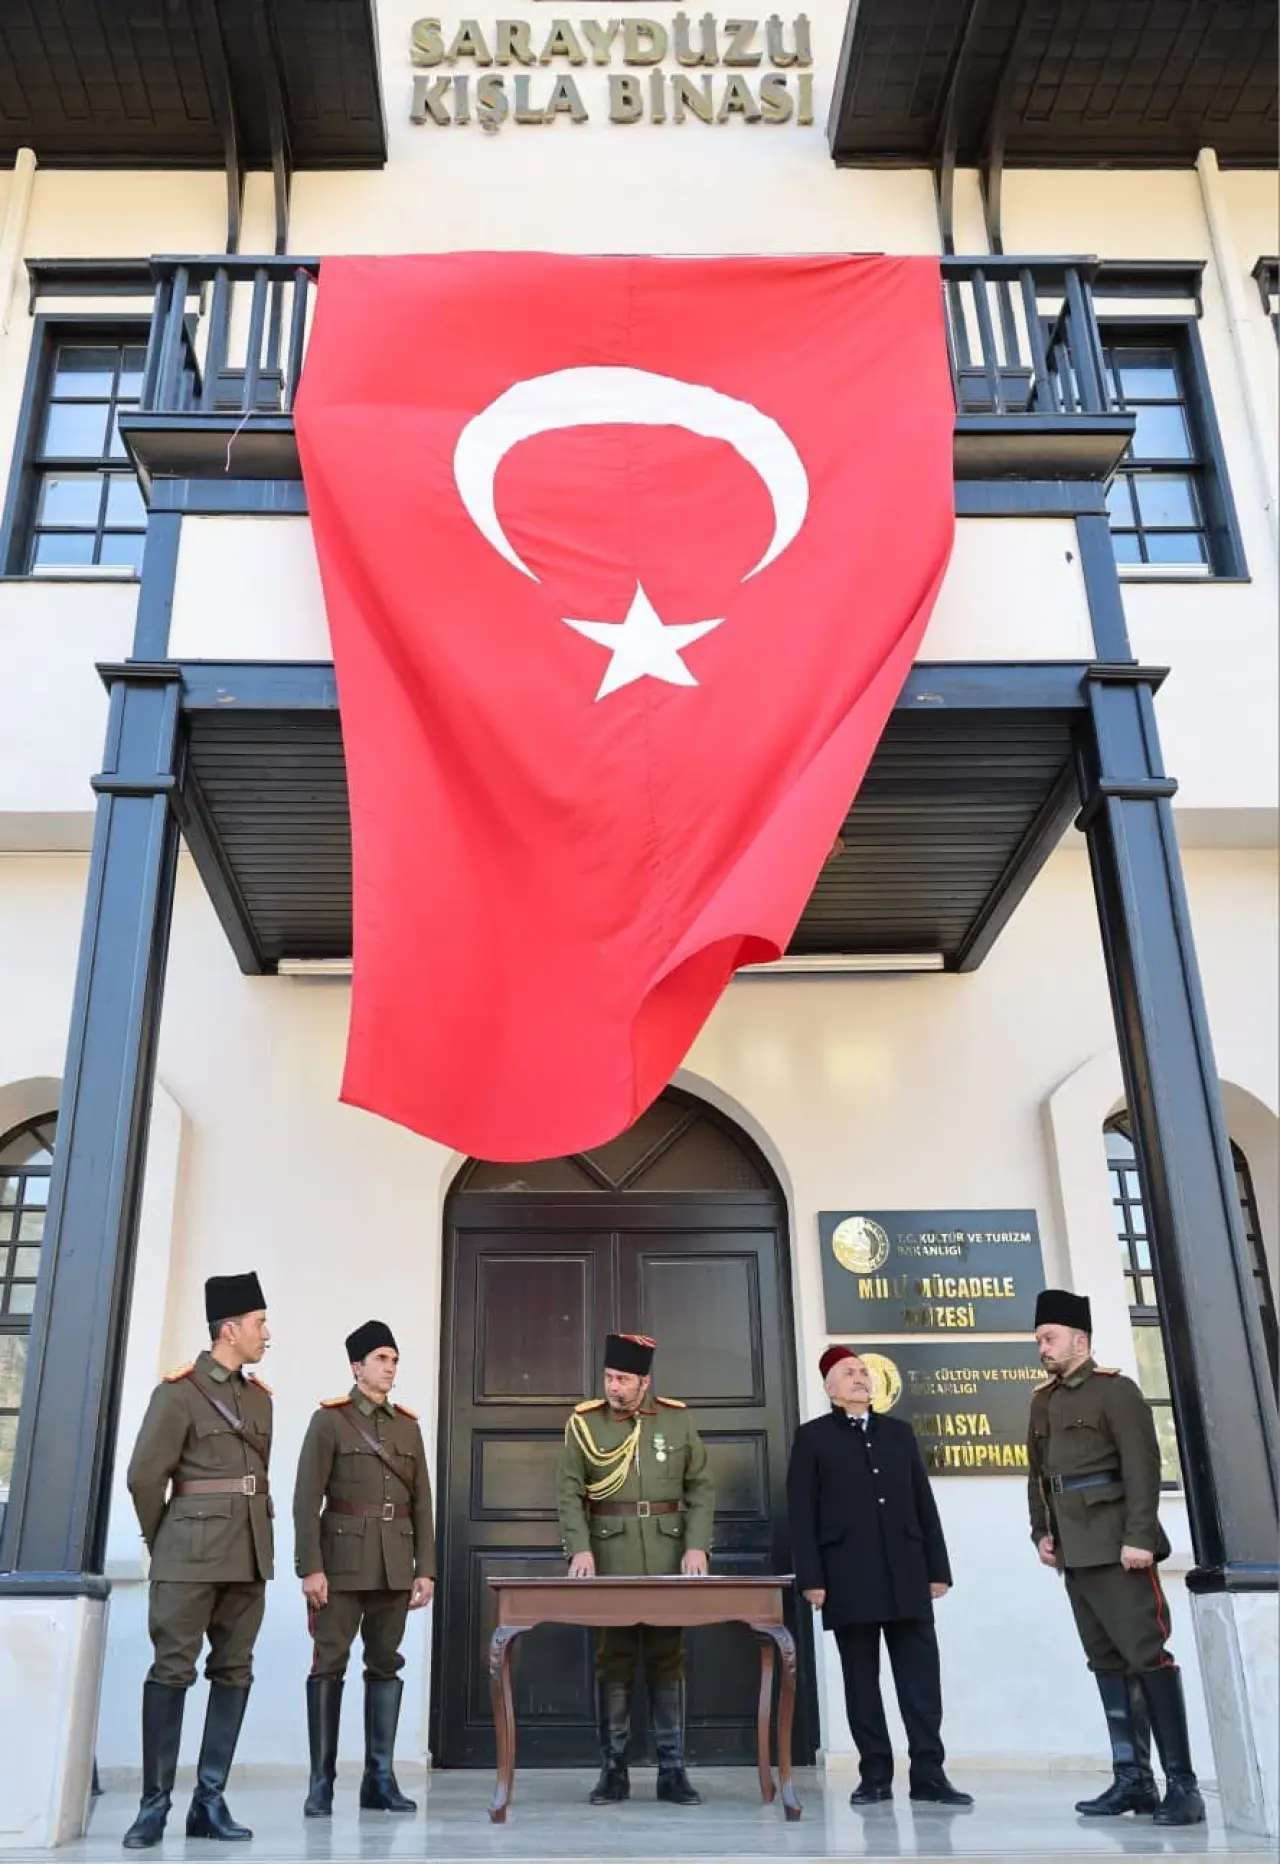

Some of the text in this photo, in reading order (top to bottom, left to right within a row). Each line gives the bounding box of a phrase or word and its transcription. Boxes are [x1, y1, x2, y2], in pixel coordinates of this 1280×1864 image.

[409, 11, 813, 67] SARAYDÜZÜ
[409, 67, 814, 136] KIŞLA BİNASI
[967, 1233, 985, 1244] VE
[987, 1231, 1031, 1243] TURİZM
[982, 1370, 999, 1380] VE
